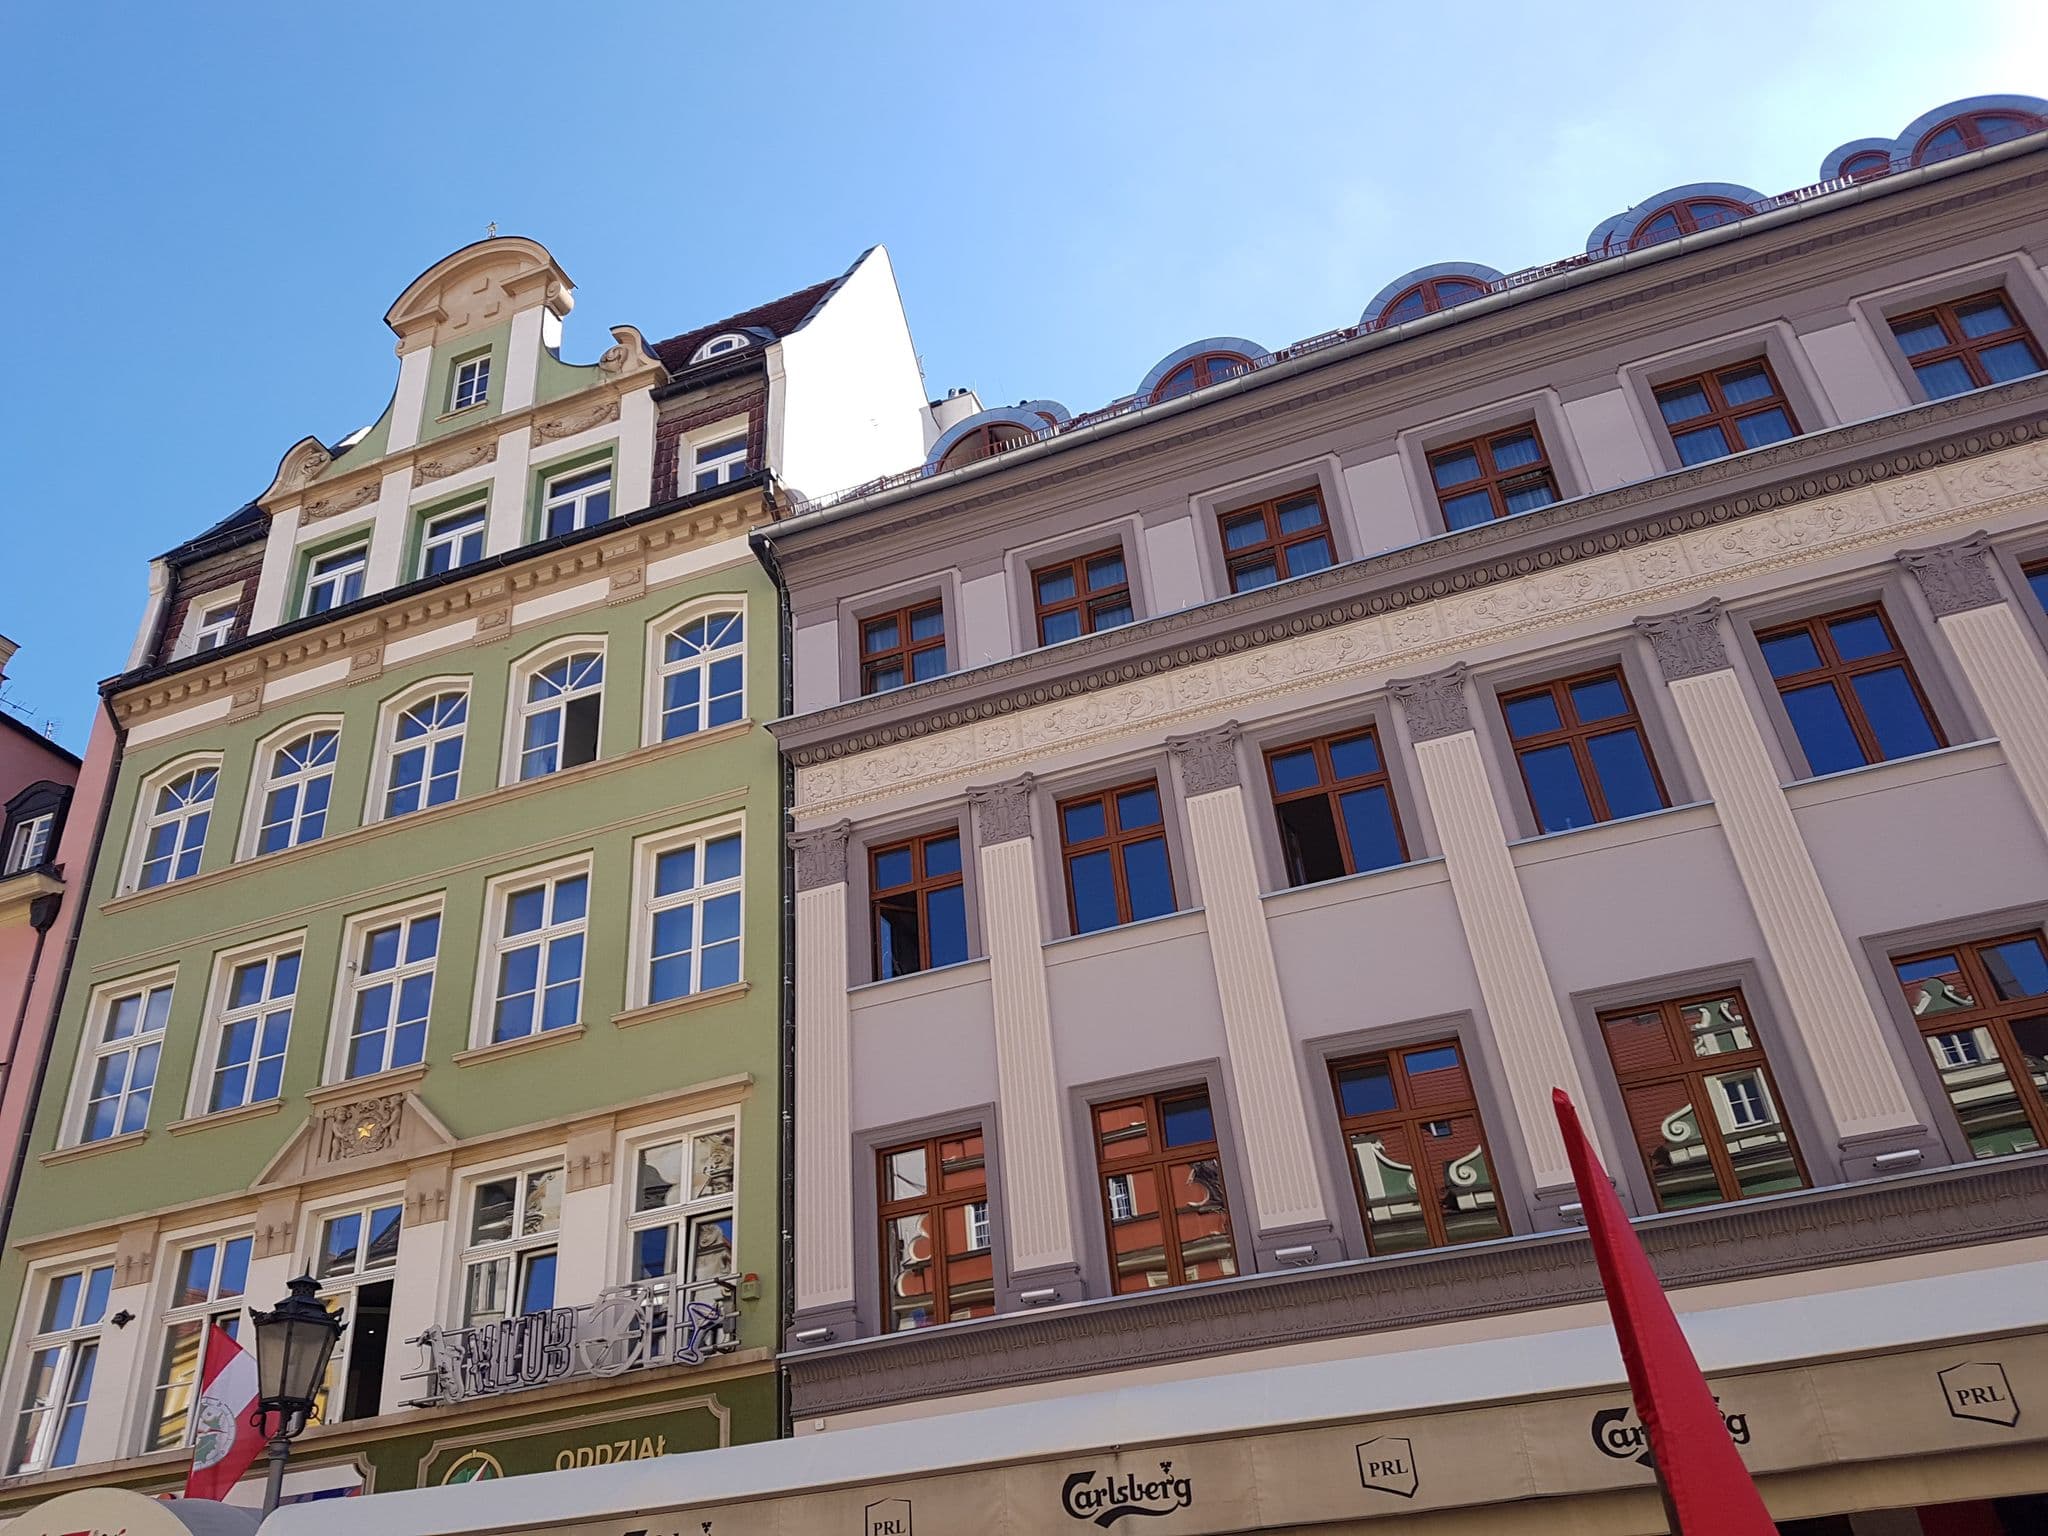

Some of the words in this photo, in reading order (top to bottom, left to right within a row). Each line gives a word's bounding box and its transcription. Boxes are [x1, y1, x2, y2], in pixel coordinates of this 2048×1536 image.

[466, 1306, 578, 1395] KLUB
[1955, 1385, 2005, 1406] PRL
[555, 1435, 665, 1471] ODDZIAŁ
[1368, 1459, 1409, 1478] PRL
[1061, 1470, 1192, 1520] Carlsberg
[872, 1519, 907, 1536] PRL
